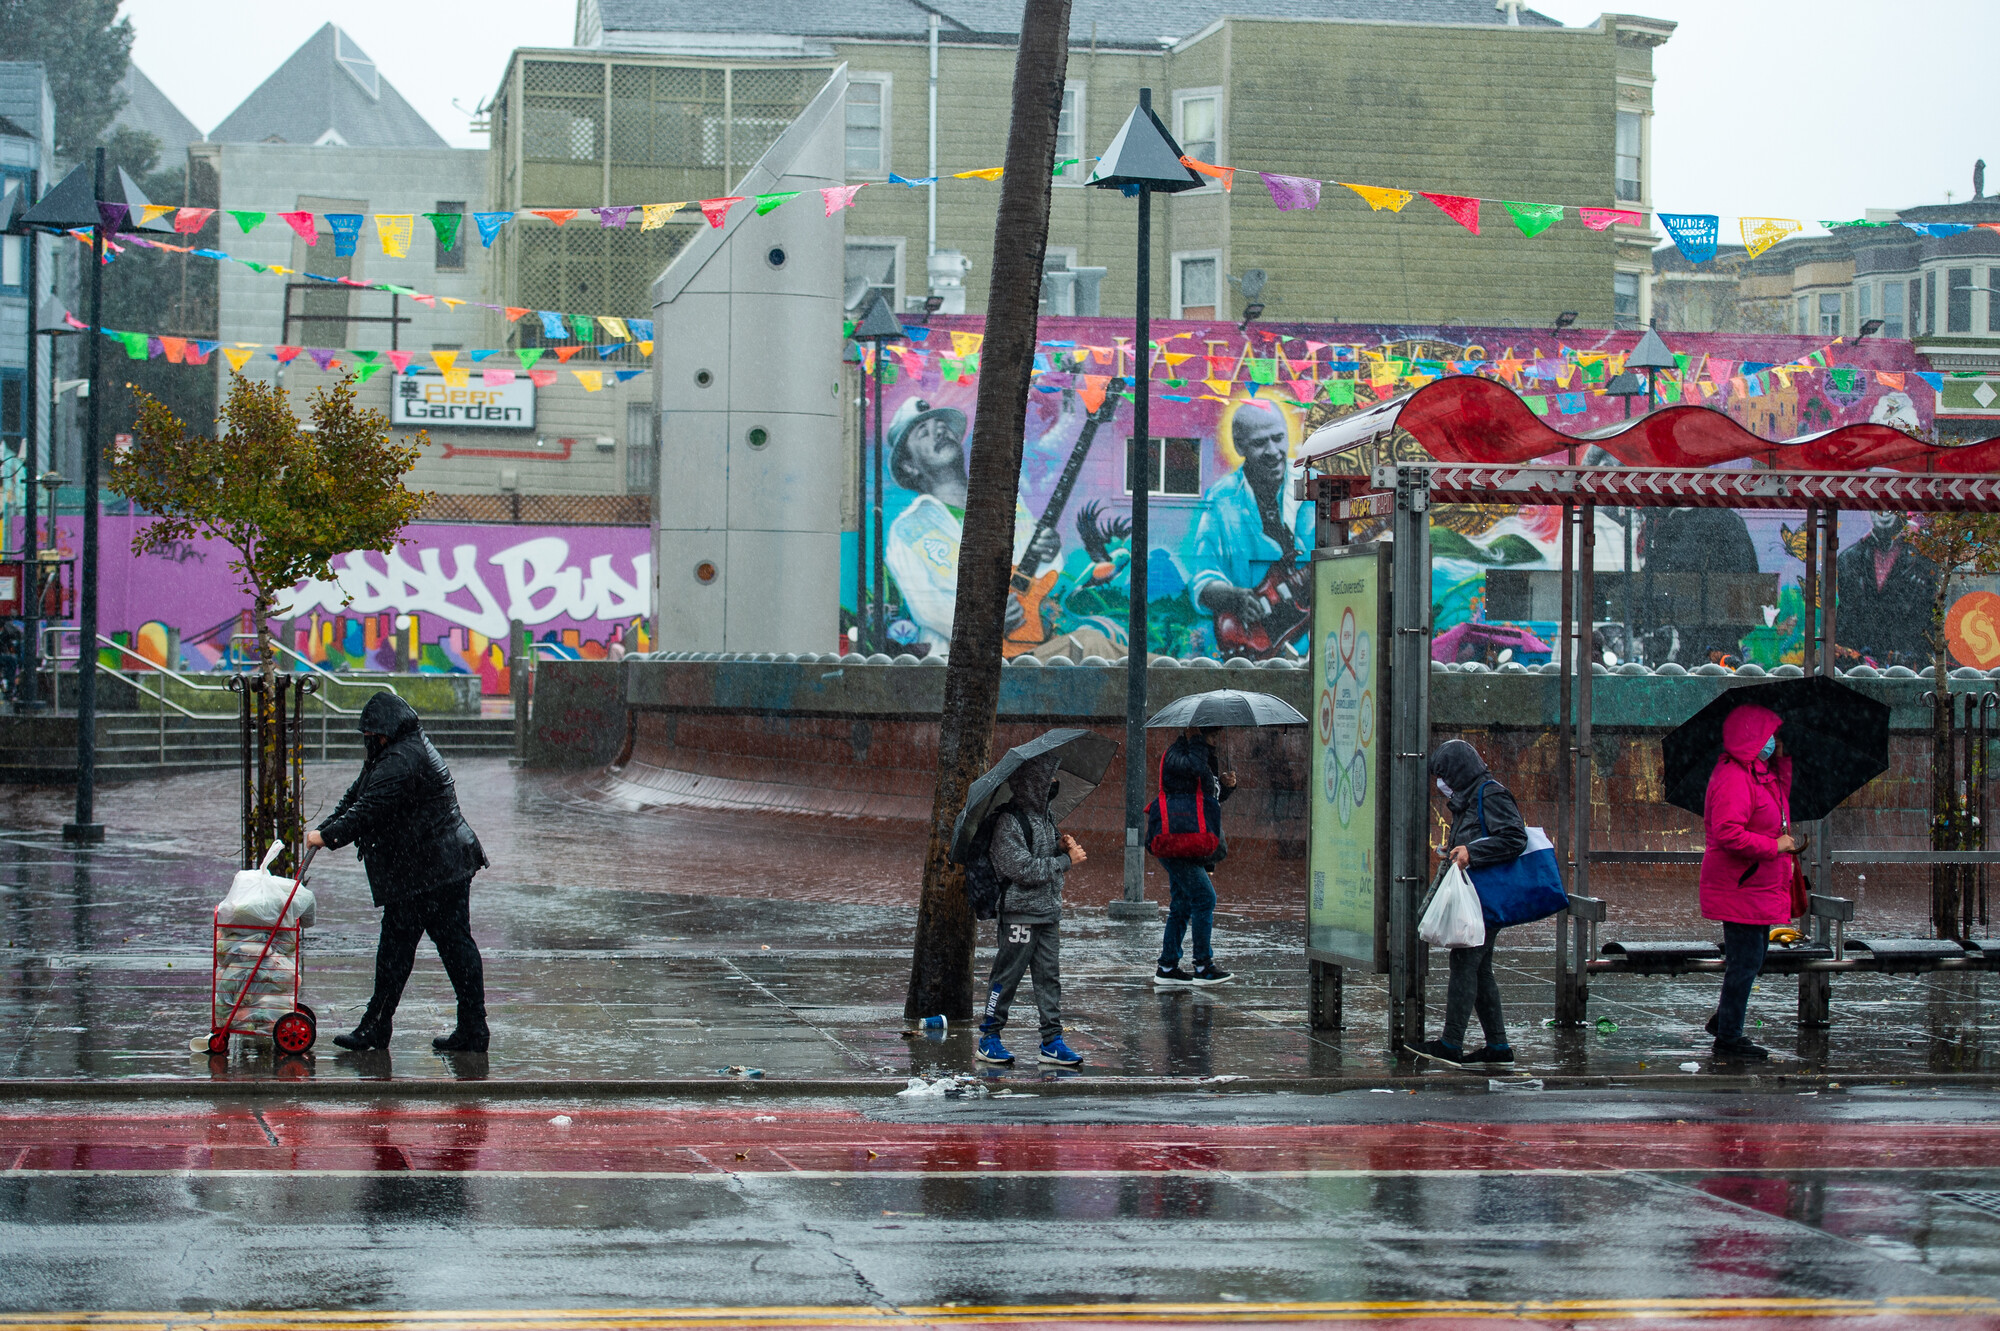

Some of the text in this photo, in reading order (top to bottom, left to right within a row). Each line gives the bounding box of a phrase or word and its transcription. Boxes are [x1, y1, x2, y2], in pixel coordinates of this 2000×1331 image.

[425, 383, 503, 404] Beer
[405, 398, 522, 421] Garden
[1008, 924, 1032, 944] 35
